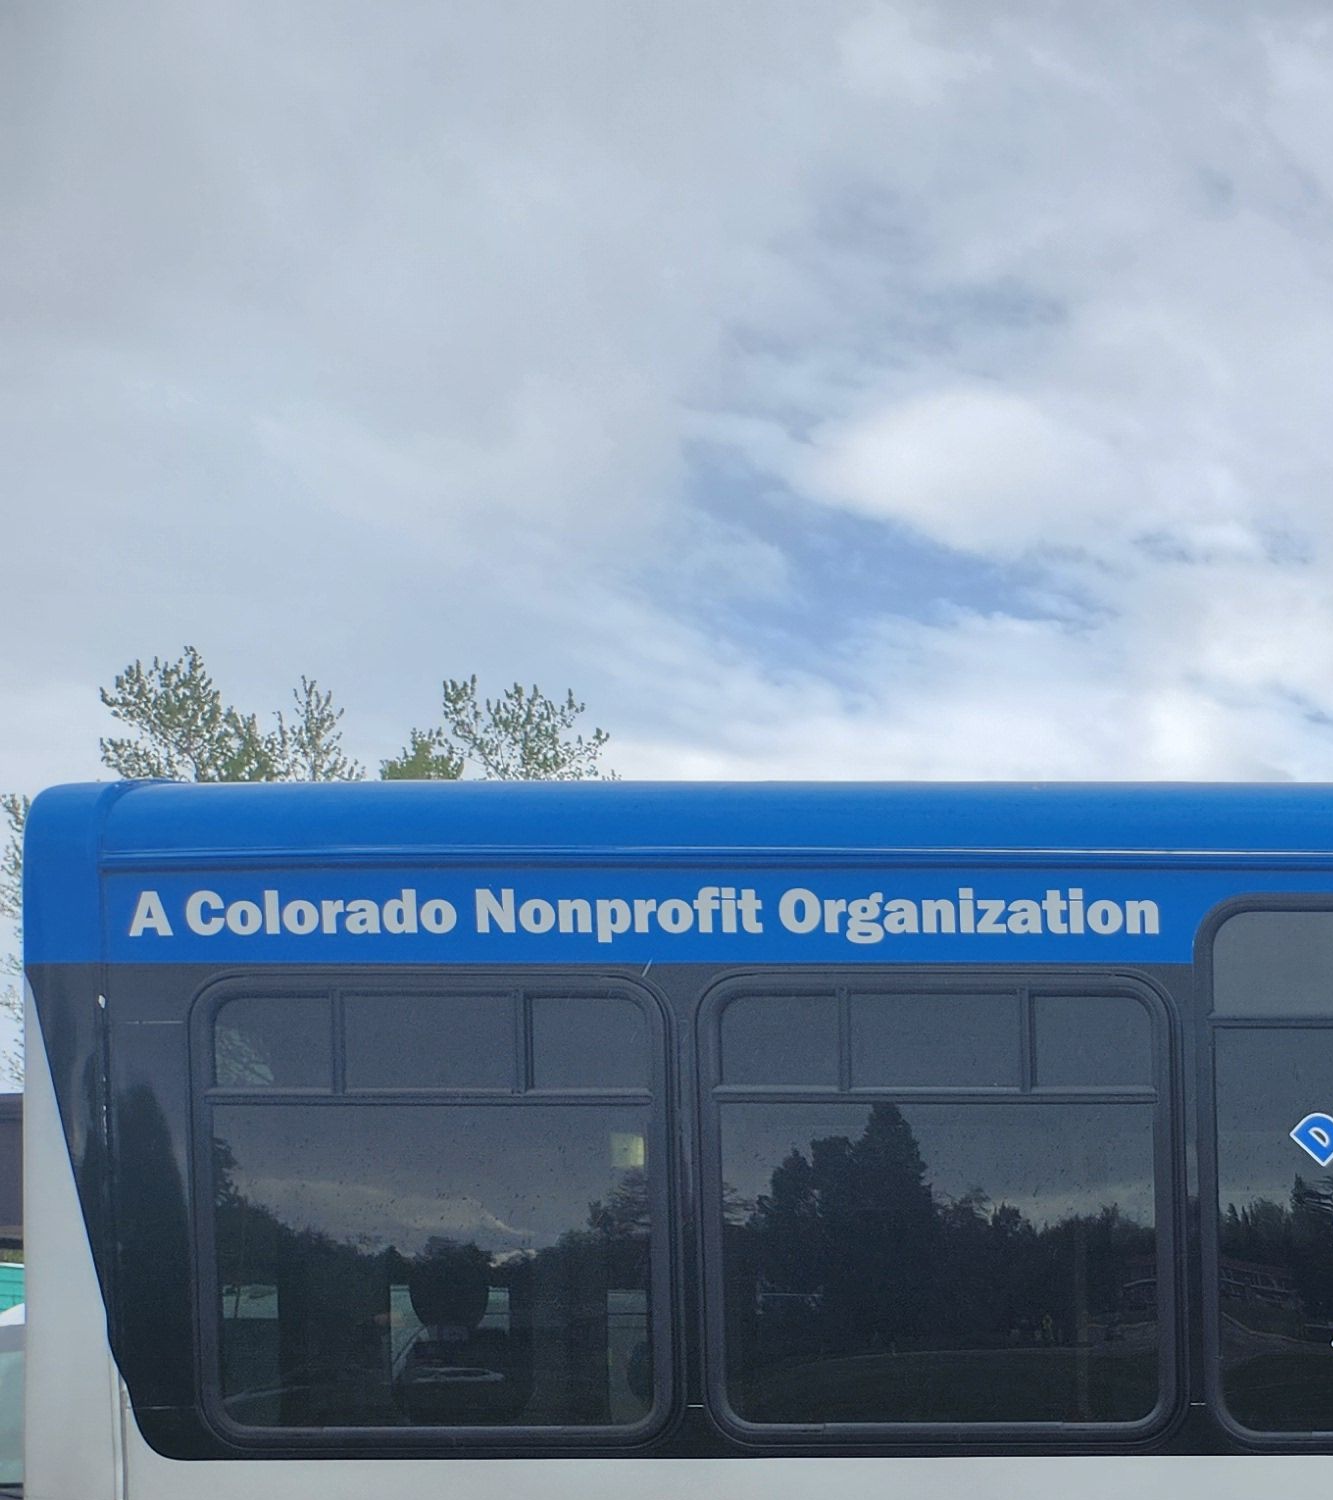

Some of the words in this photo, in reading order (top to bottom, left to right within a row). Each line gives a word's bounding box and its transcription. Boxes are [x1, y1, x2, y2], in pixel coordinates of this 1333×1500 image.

[130, 891, 172, 937] A
[186, 889, 457, 936] Colorado
[475, 887, 763, 943] Nonprofit
[779, 887, 1159, 944] Organization
